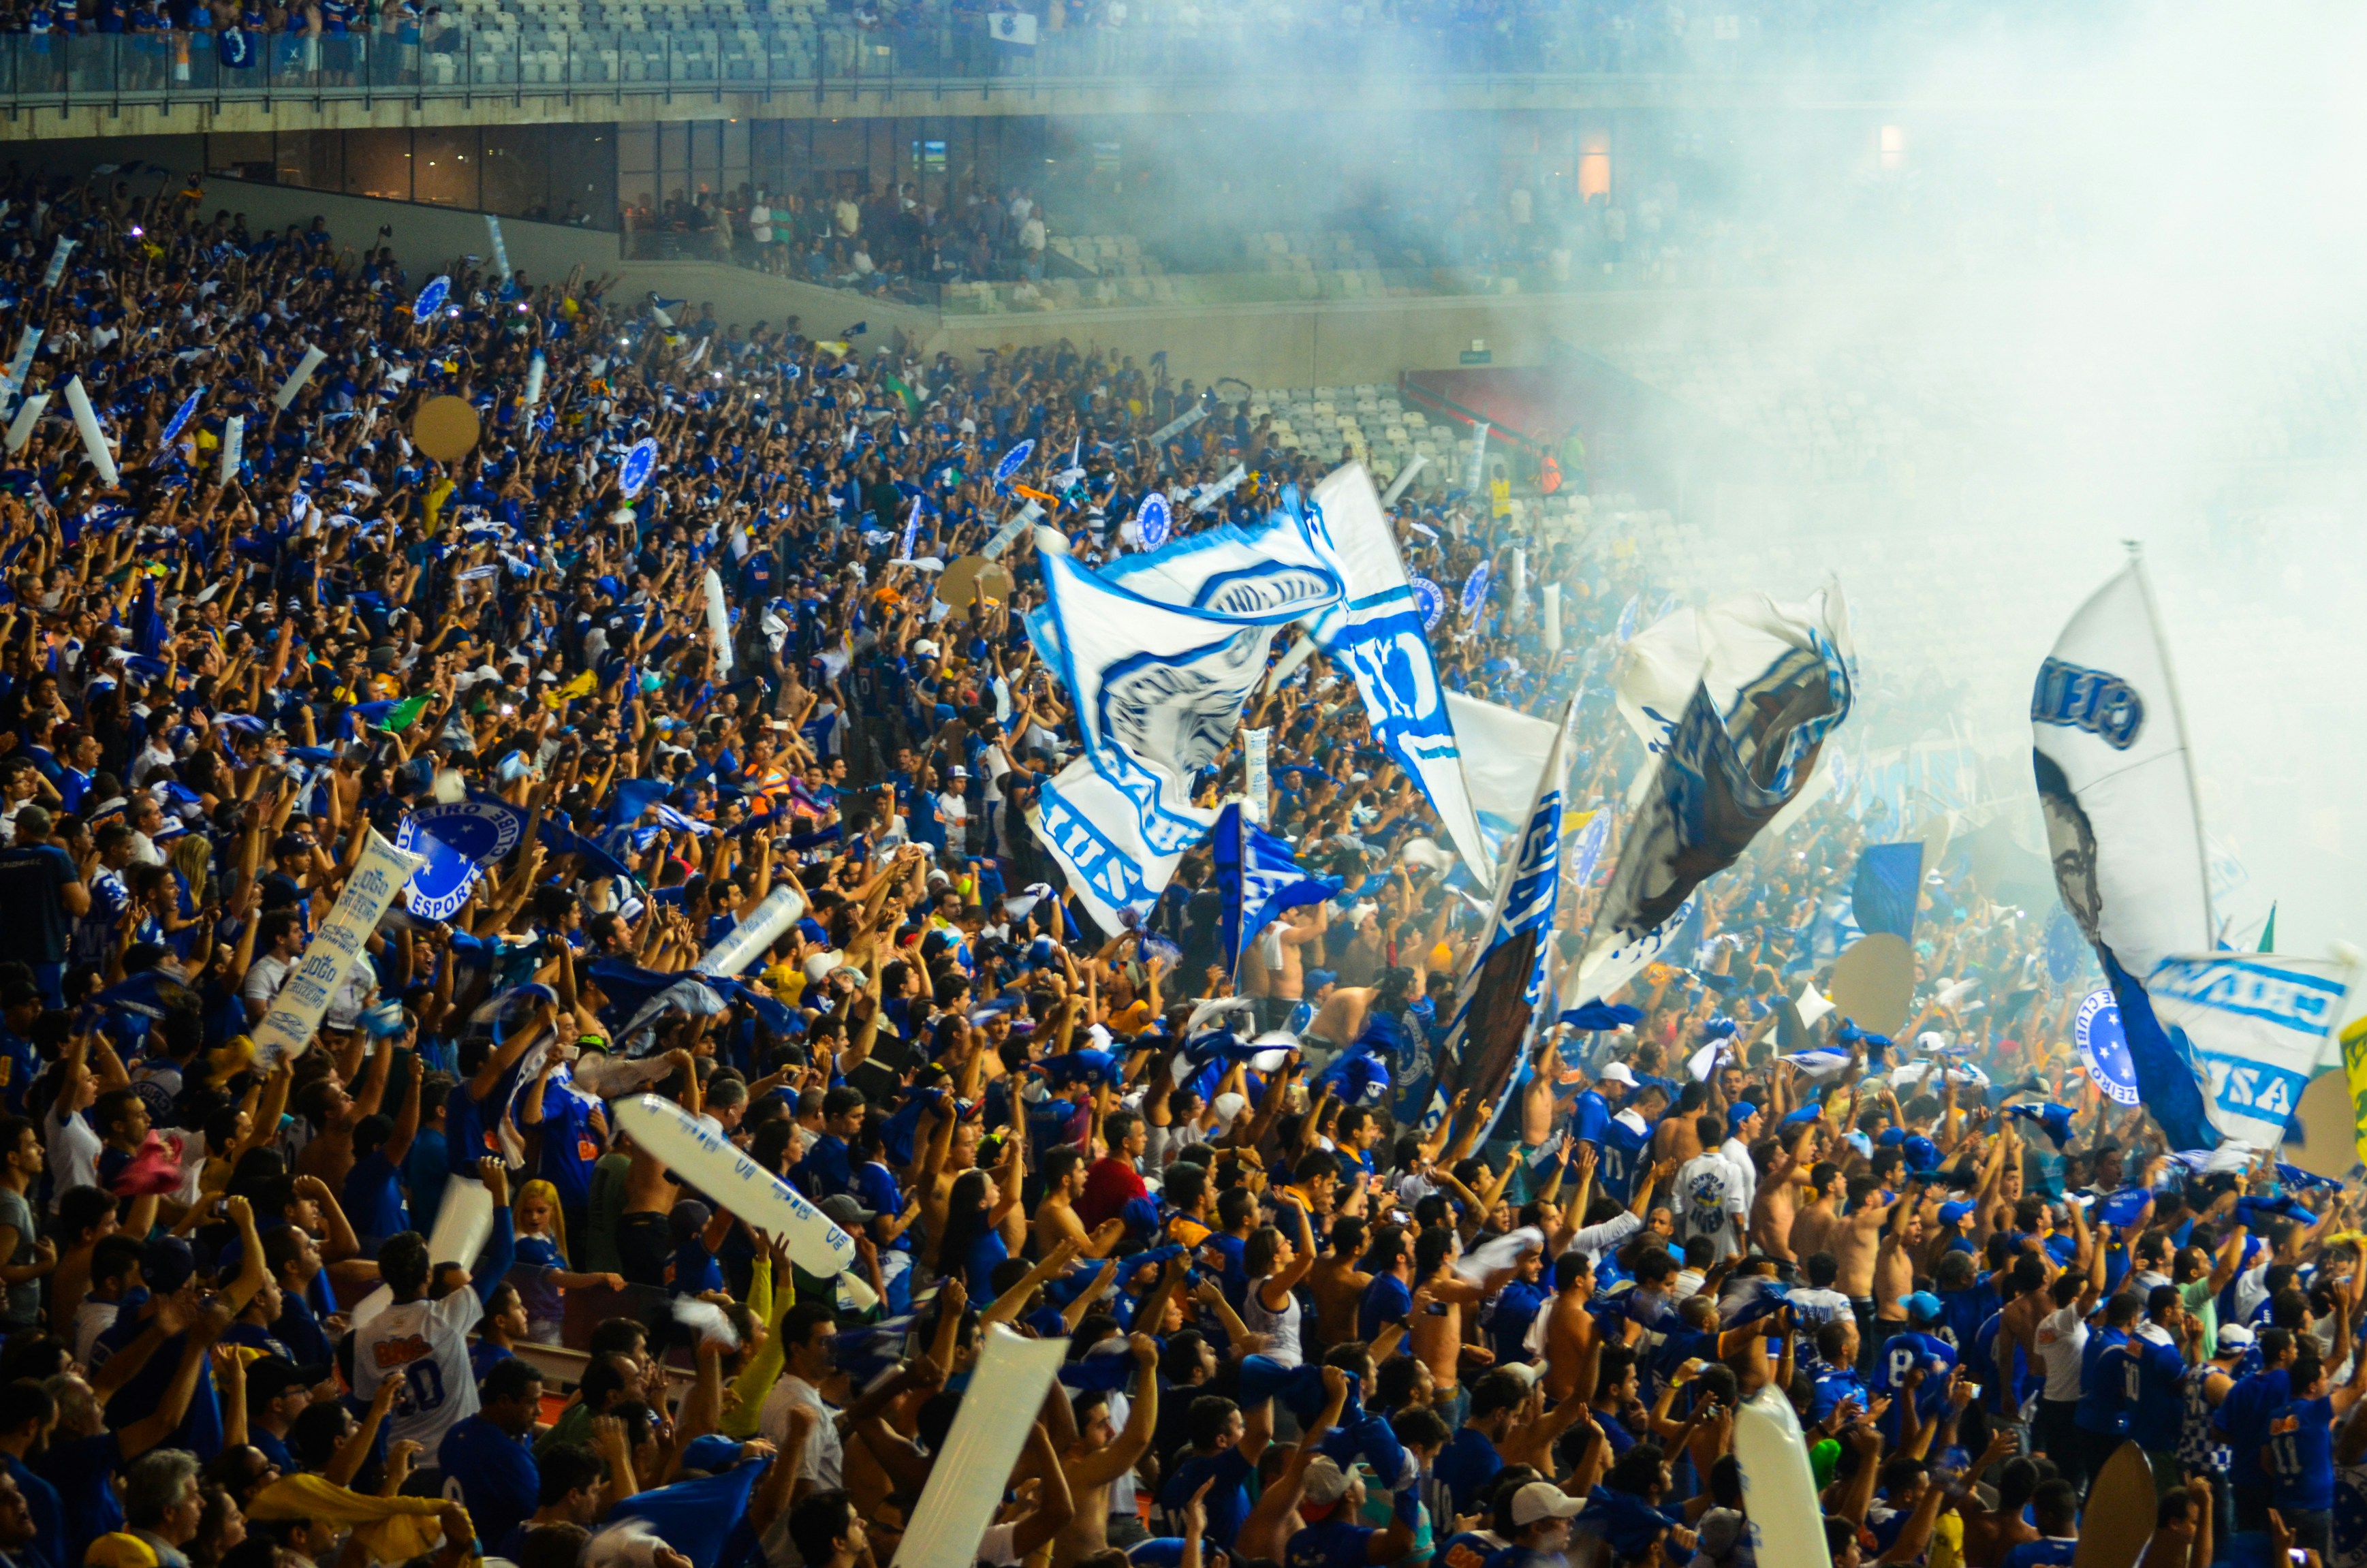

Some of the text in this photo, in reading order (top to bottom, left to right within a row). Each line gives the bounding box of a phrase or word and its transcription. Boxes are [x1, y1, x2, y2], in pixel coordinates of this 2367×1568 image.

[1412, 579, 1442, 603] UZEIRO
[489, 809, 517, 857] CLUBE
[300, 954, 337, 983] JOGO
[285, 981, 325, 1010] CRUZEIRO
[2077, 997, 2100, 1056] CLUBE
[2090, 1065, 2136, 1102] ZEIRO
[1887, 1348, 1914, 1388] 8
